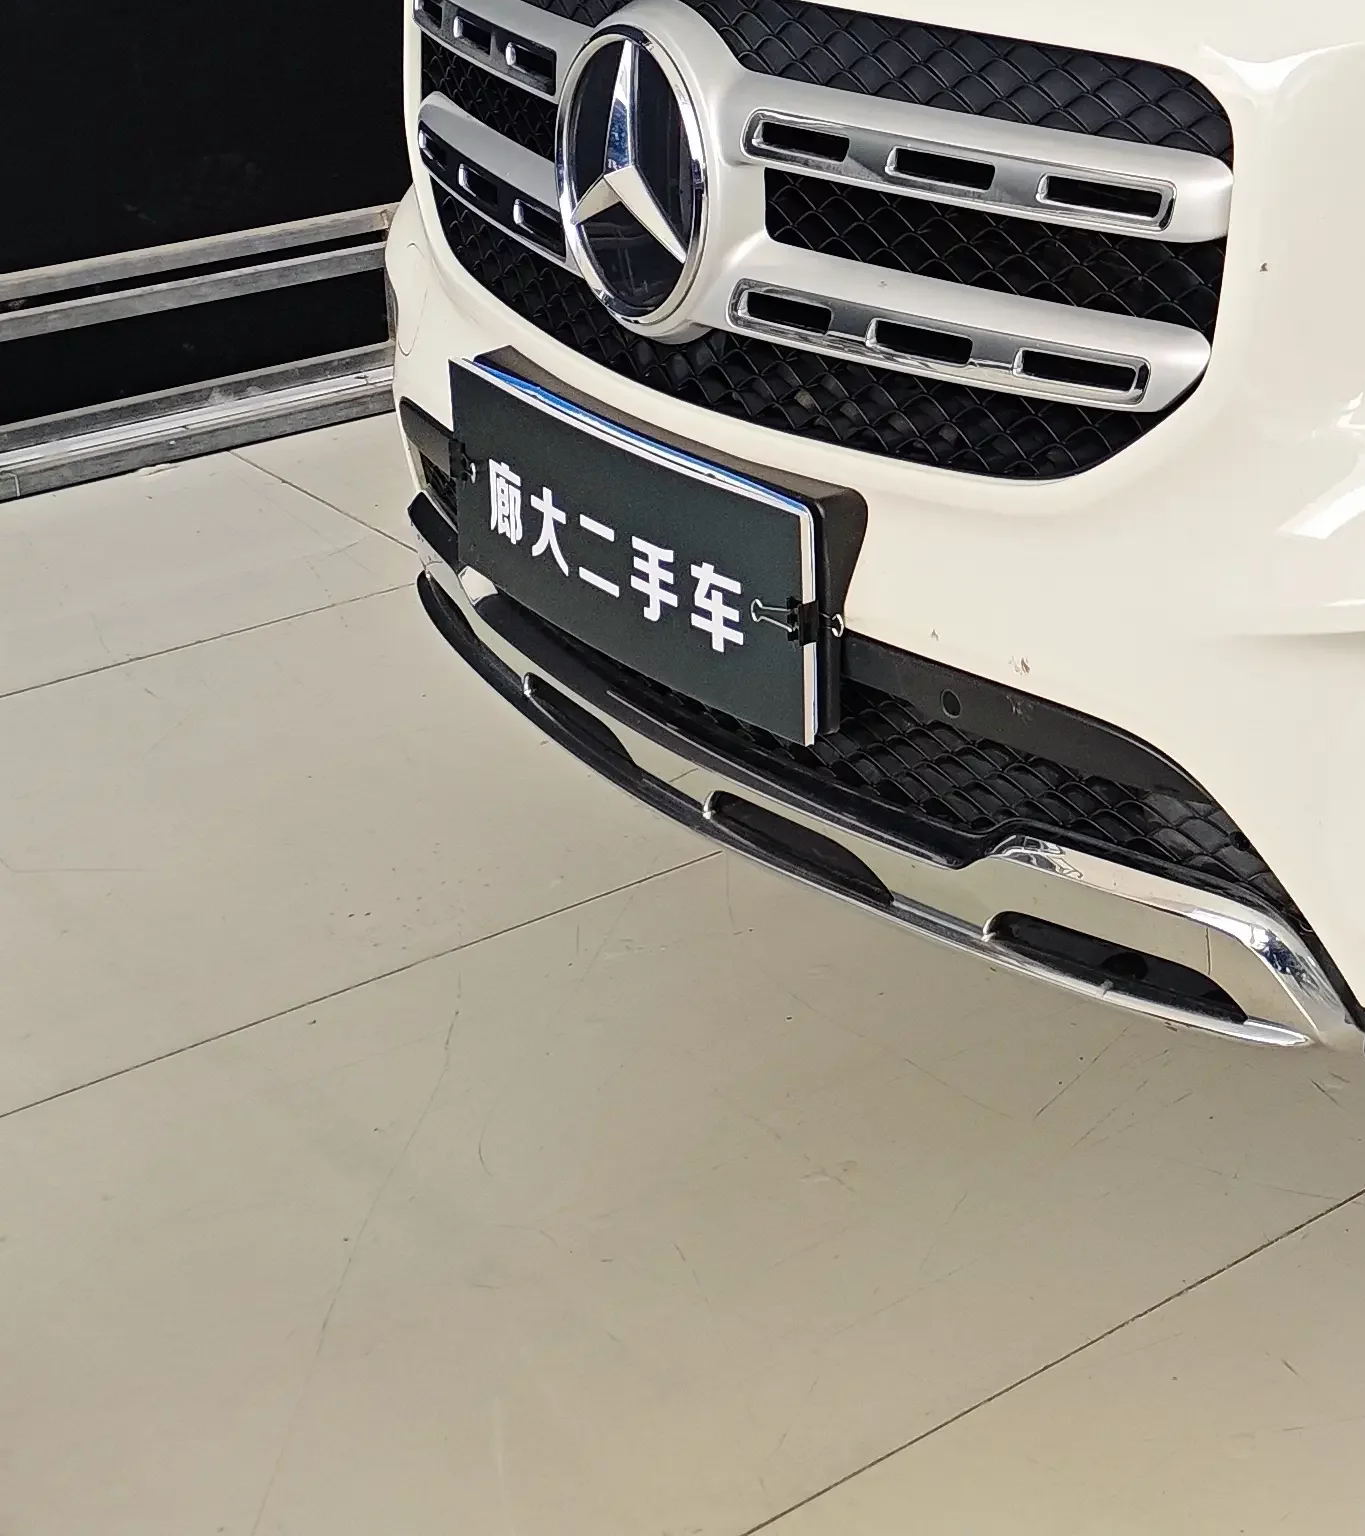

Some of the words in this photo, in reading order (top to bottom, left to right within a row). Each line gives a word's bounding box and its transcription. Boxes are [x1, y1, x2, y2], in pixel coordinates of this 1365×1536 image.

[487, 458, 745, 653] 廊大二手车
